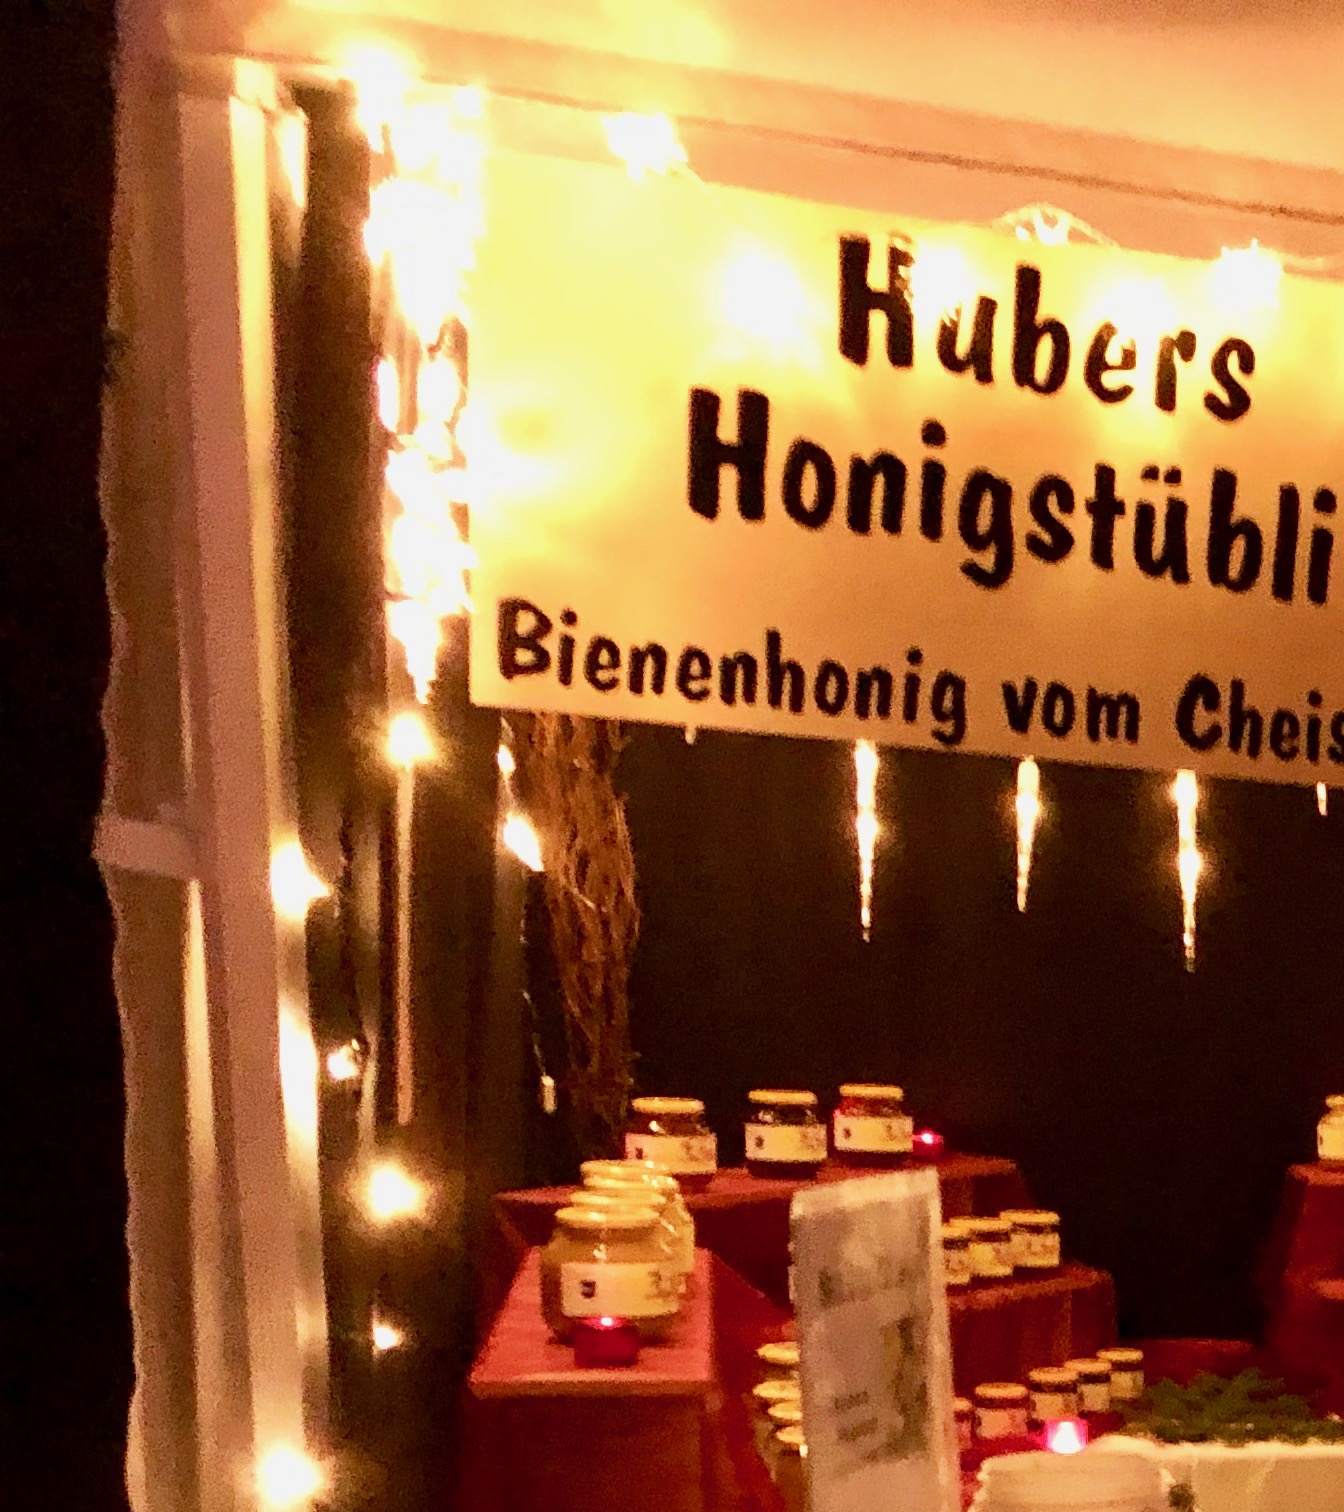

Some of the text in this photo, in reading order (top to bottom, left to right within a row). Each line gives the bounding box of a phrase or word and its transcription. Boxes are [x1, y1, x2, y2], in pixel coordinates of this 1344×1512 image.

[838, 234, 1256, 422] Hubers
[687, 388, 1338, 608] Honigstübli
[497, 598, 967, 746] Bienenhonig
[1000, 674, 1143, 748] vom
